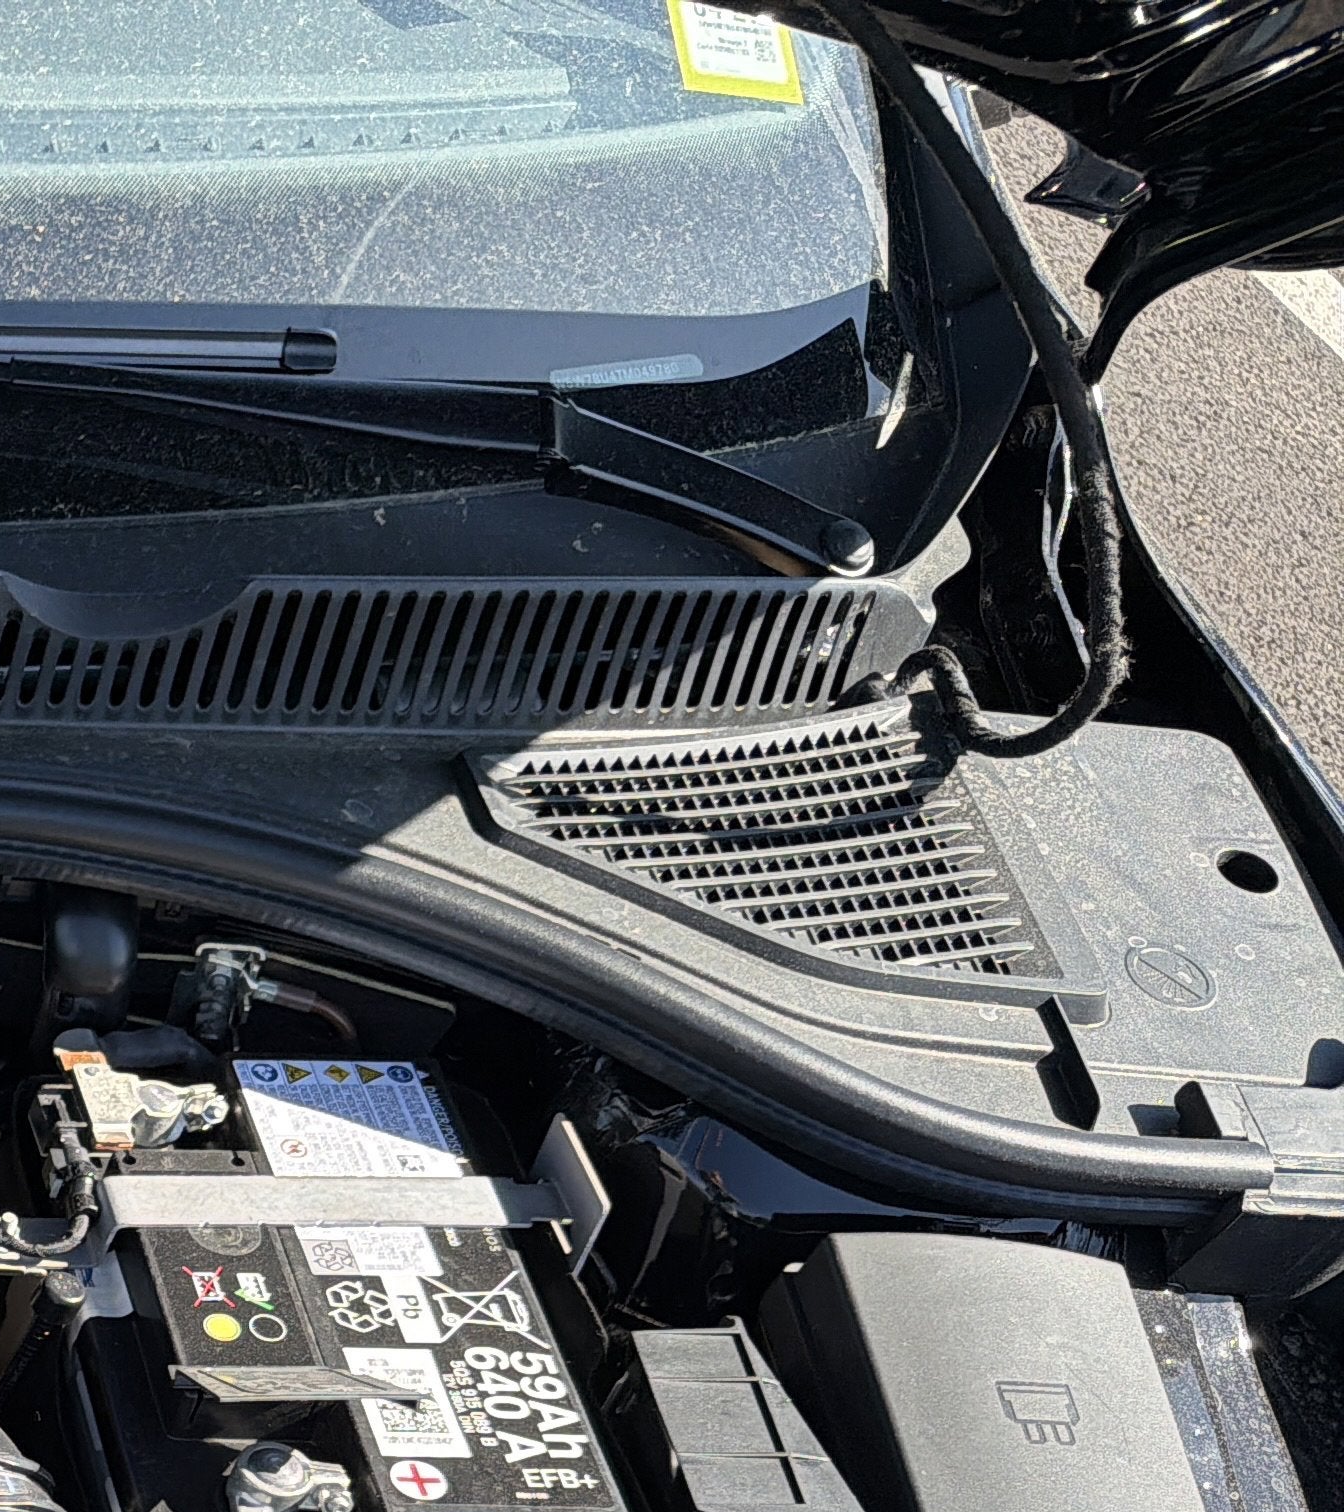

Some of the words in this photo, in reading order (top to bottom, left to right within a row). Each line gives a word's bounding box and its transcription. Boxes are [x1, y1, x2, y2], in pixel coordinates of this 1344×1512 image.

[396, 1294, 423, 1319] Pb
[464, 1346, 531, 1419] 640
[509, 1350, 589, 1459] 59Ah
[495, 1430, 548, 1464] A
[521, 1467, 601, 1489] EFB+
